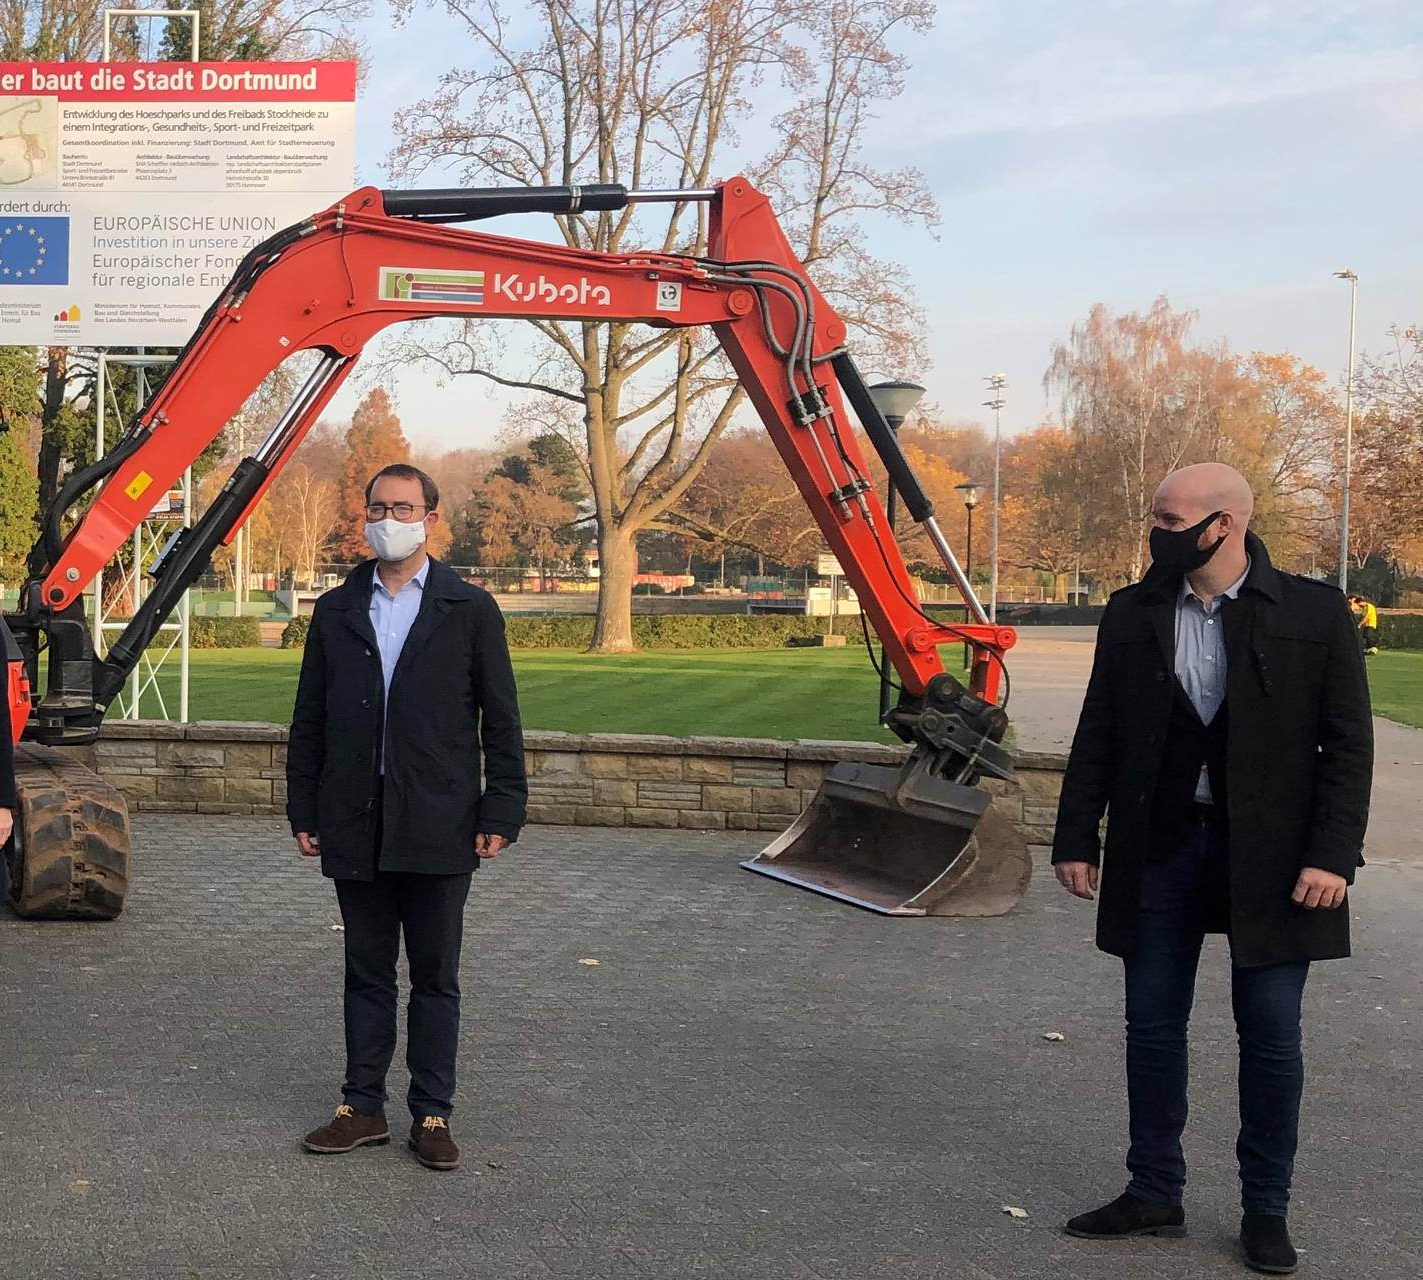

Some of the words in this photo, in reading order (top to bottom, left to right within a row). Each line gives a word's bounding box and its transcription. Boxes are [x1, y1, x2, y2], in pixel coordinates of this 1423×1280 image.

[32, 68, 83, 91] baut
[90, 68, 125, 91] die
[132, 68, 194, 91] Stadt
[201, 68, 317, 91] Dortmund
[63, 109, 117, 120] Entwicklung
[118, 109, 134, 120] des
[136, 109, 191, 120] Hoeschparks
[192, 109, 210, 120] und
[211, 109, 227, 120] des
[228, 109, 265, 120] Freibads
[267, 109, 317, 120] Stockheide
[63, 122, 90, 131] einem
[92, 122, 150, 133] Integrations-,
[152, 122, 212, 133] Gesundheits-,
[213, 122, 241, 133] Sport-
[242, 122, 260, 131] und
[262, 122, 315, 133] Freizeitpark
[32, 200, 71, 213] durch:
[93, 214, 215, 231] EUROPÄISCHE
[220, 216, 276, 231] UNION
[93, 236, 168, 248] Investition
[172, 236, 185, 248] in
[189, 239, 238, 248] unsere
[93, 254, 200, 271] Europäischer
[92, 273, 115, 286] für
[120, 273, 195, 289] regionale
[494, 273, 611, 306] Kubota
